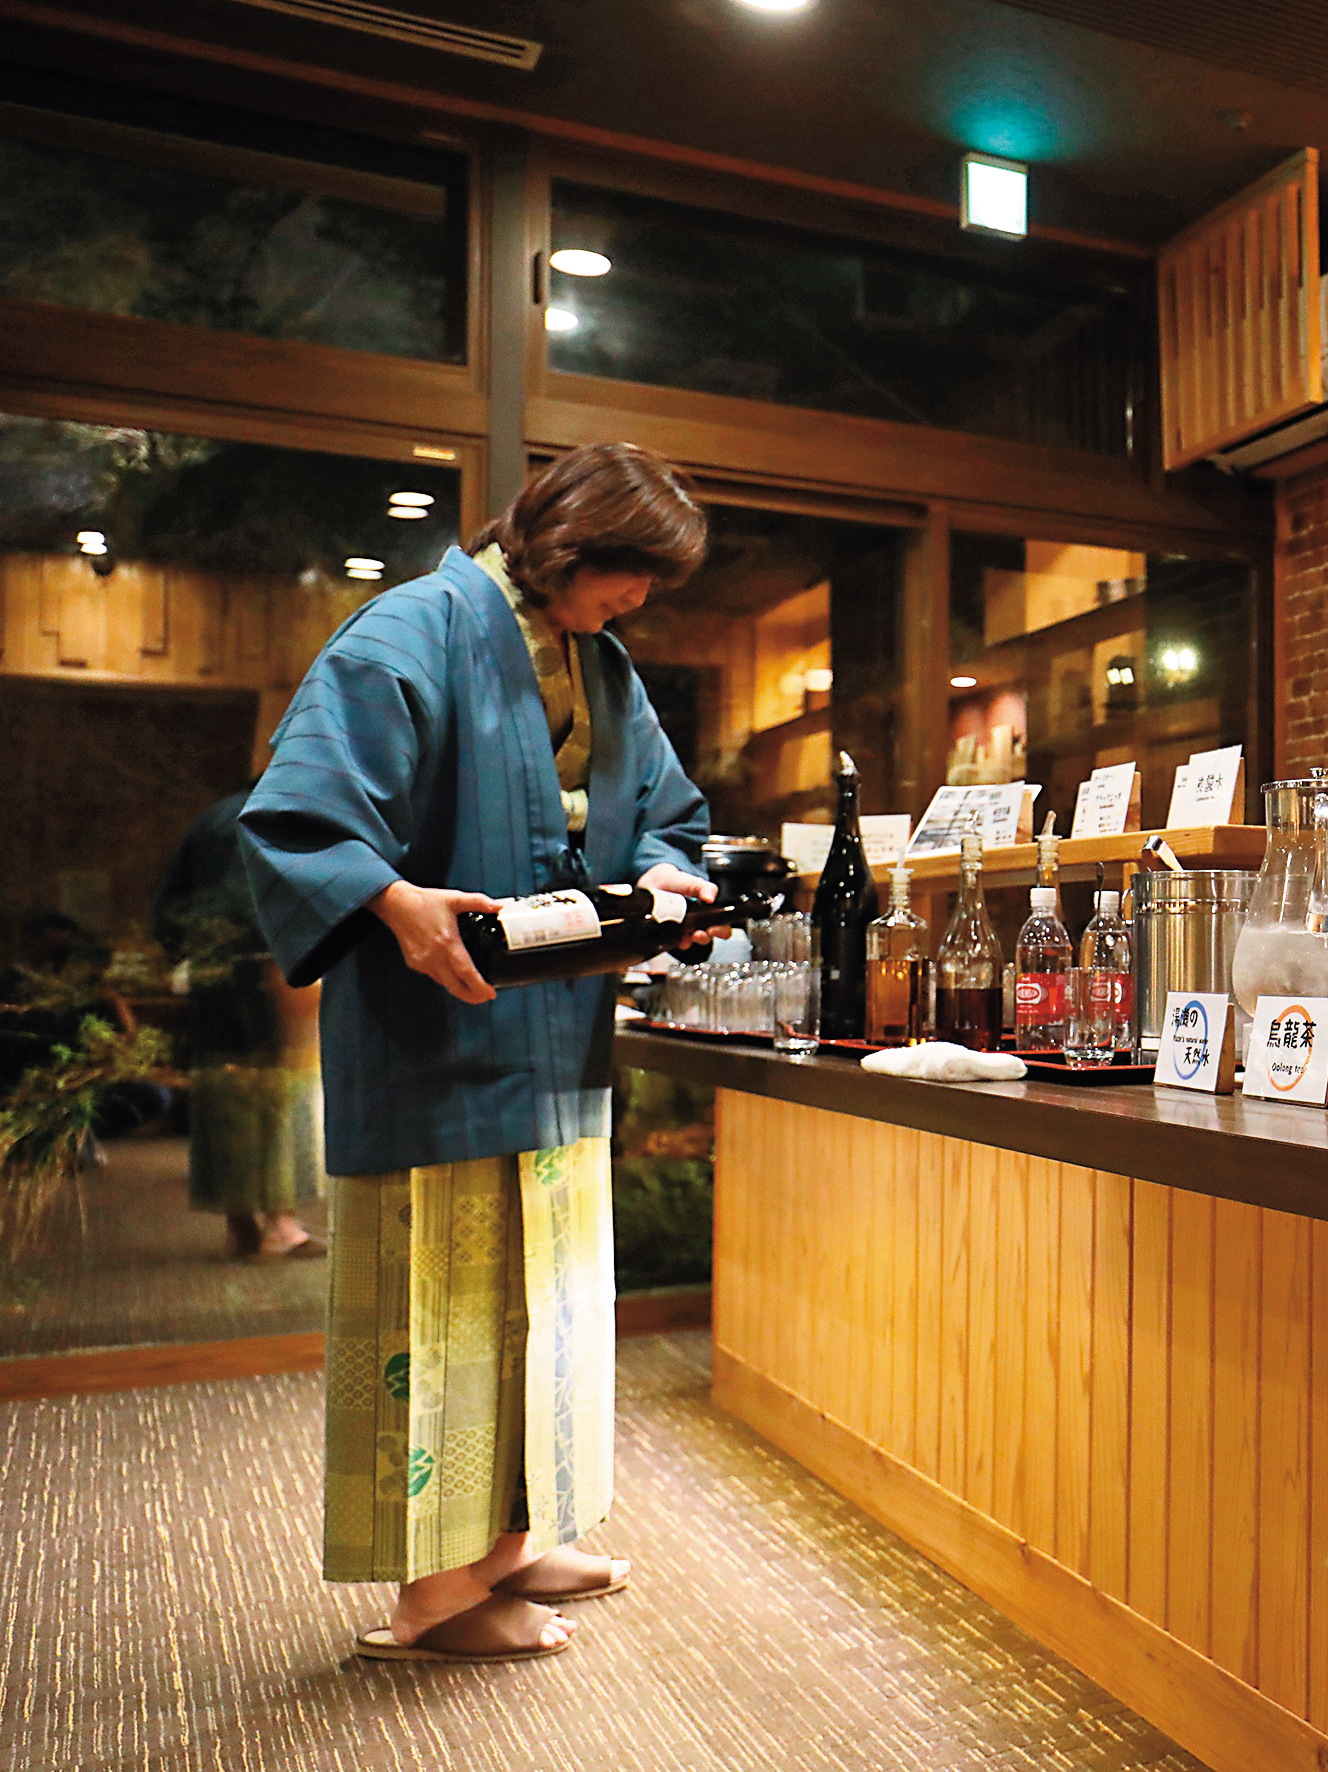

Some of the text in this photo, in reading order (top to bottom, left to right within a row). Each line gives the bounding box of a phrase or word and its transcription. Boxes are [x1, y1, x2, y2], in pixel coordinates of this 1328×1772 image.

[1266, 1018, 1317, 1049] 烏龍茶
[1183, 1046, 1210, 1067] 天然水
[1271, 1062, 1293, 1075] Oolong
